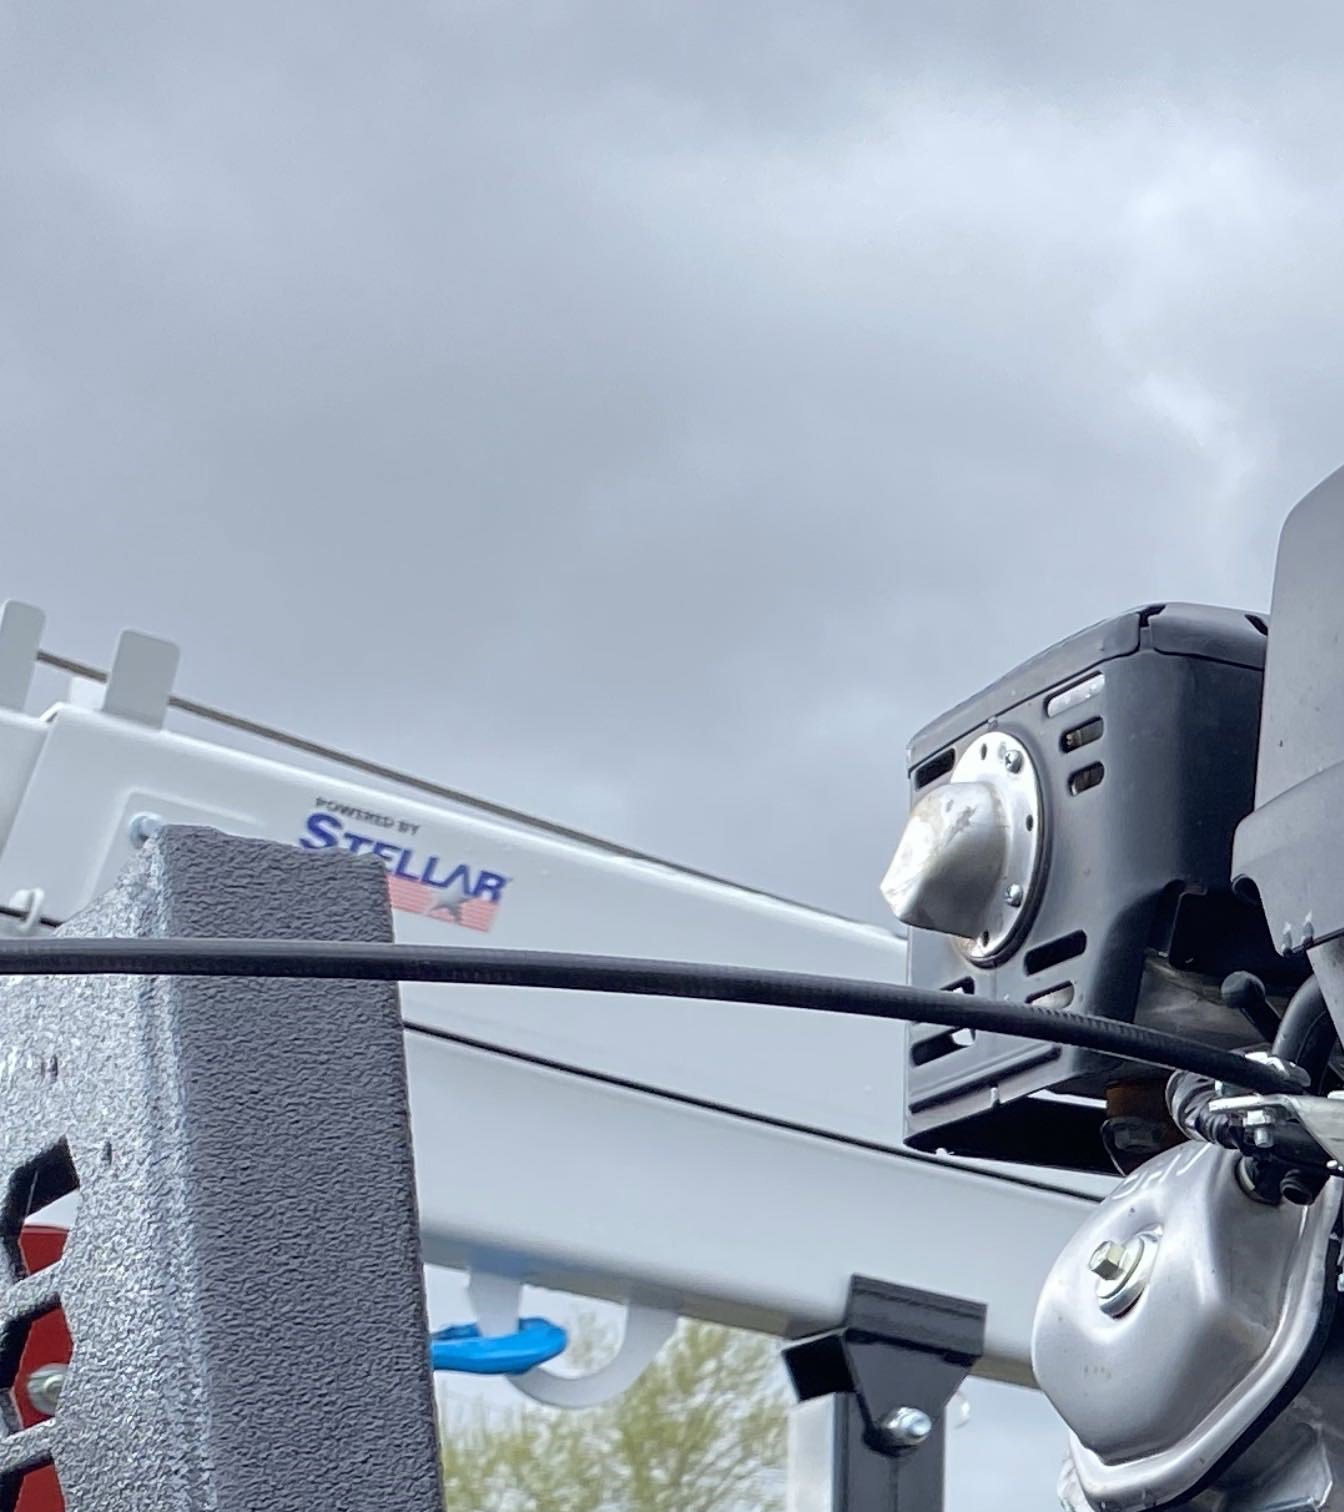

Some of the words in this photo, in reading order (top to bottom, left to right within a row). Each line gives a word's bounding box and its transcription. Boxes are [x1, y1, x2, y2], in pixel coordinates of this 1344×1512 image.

[316, 797, 394, 827] POWERED
[398, 821, 421, 836] BY
[299, 813, 512, 903] STELLAR
